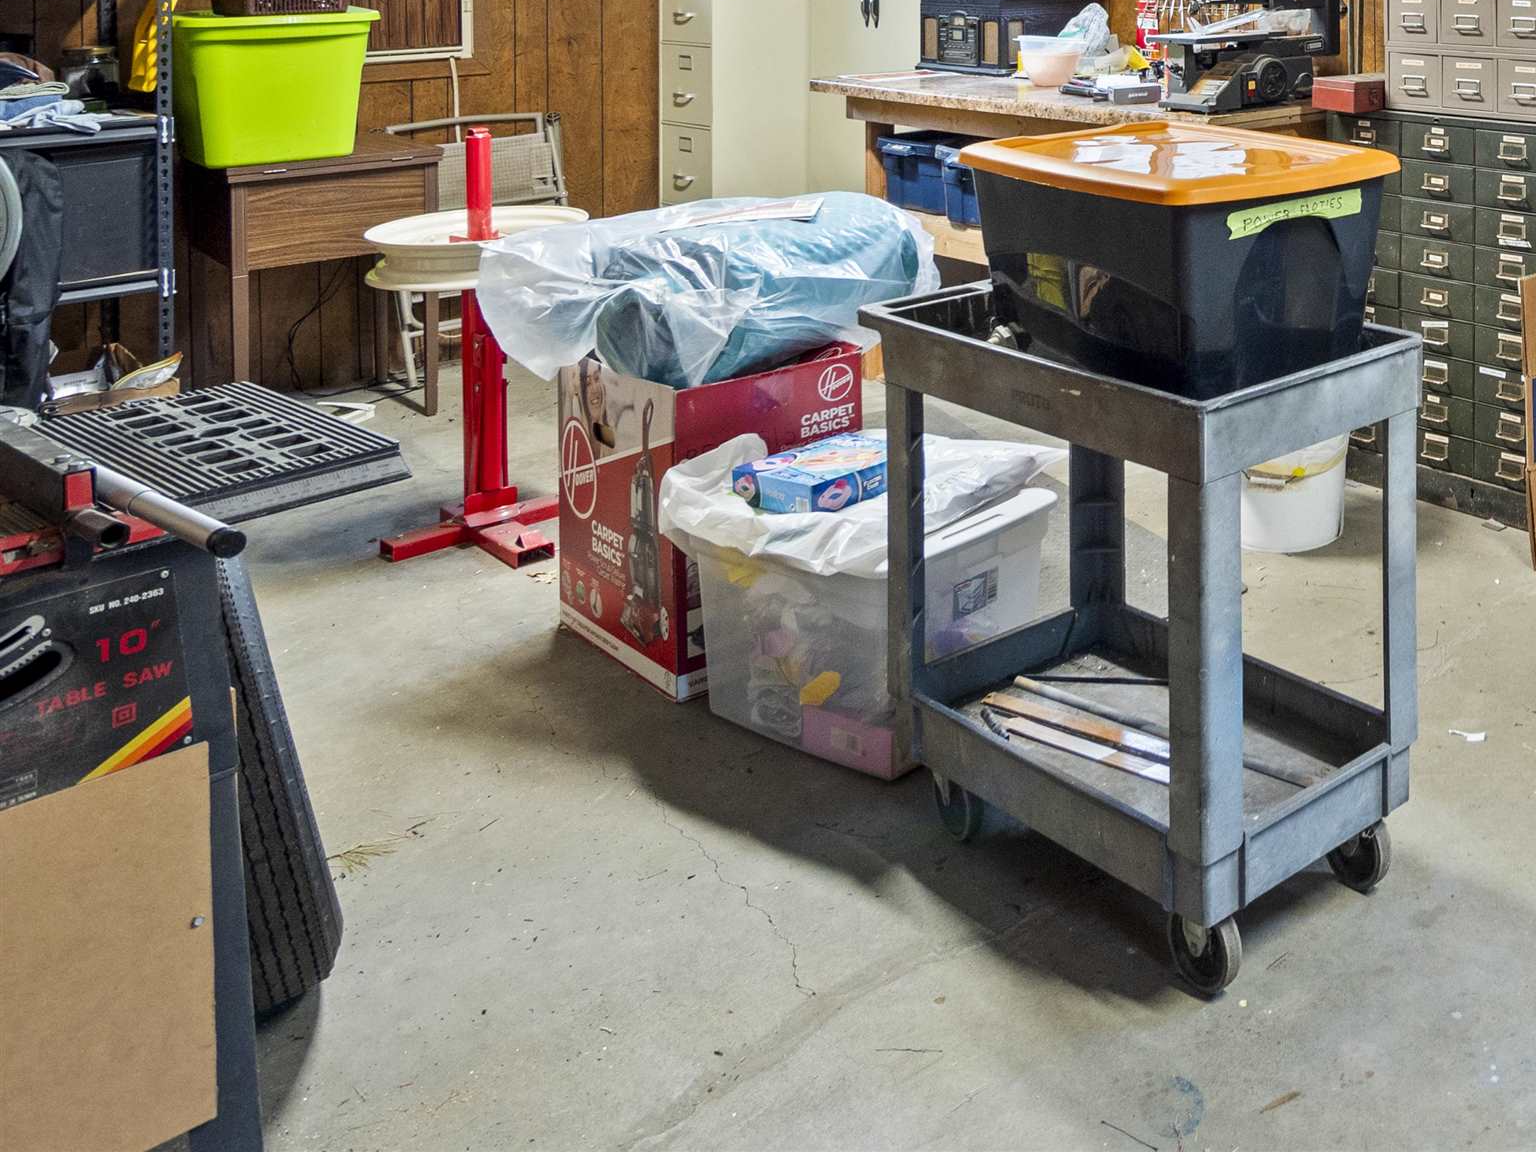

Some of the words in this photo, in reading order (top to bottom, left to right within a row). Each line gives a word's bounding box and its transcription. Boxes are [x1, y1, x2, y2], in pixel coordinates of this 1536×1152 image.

[800, 417, 850, 438] BASICS
[801, 402, 856, 426] CARPET
[591, 519, 625, 549] CARPET
[591, 535, 623, 567] BASICS
[89, 602, 105, 615] SKU
[36, 680, 108, 719] TABLE
[123, 660, 175, 689] SAW
